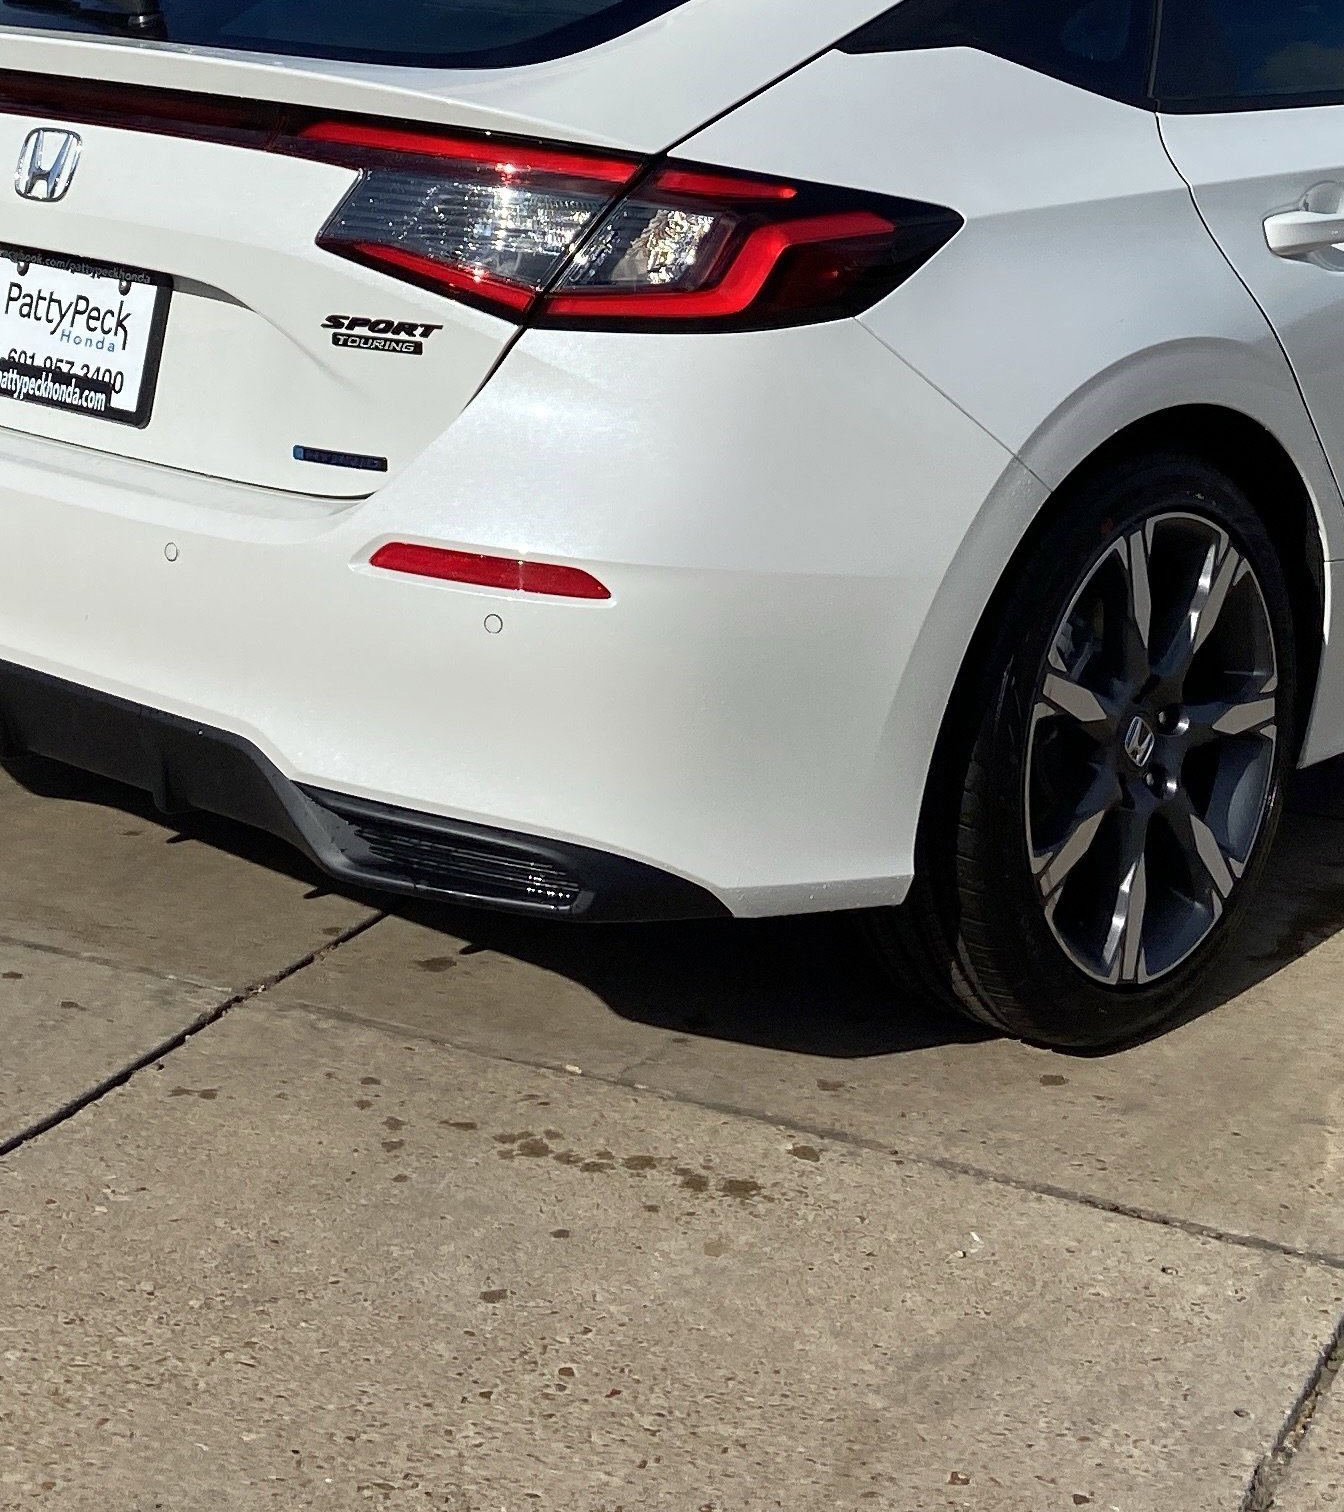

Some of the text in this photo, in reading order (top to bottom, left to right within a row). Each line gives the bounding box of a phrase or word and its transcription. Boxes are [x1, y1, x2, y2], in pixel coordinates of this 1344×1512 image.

[4, 281, 132, 351] PattyPeck
[320, 314, 444, 339] SPORT
[59, 328, 116, 353] Honda
[336, 334, 416, 353] TOURING
